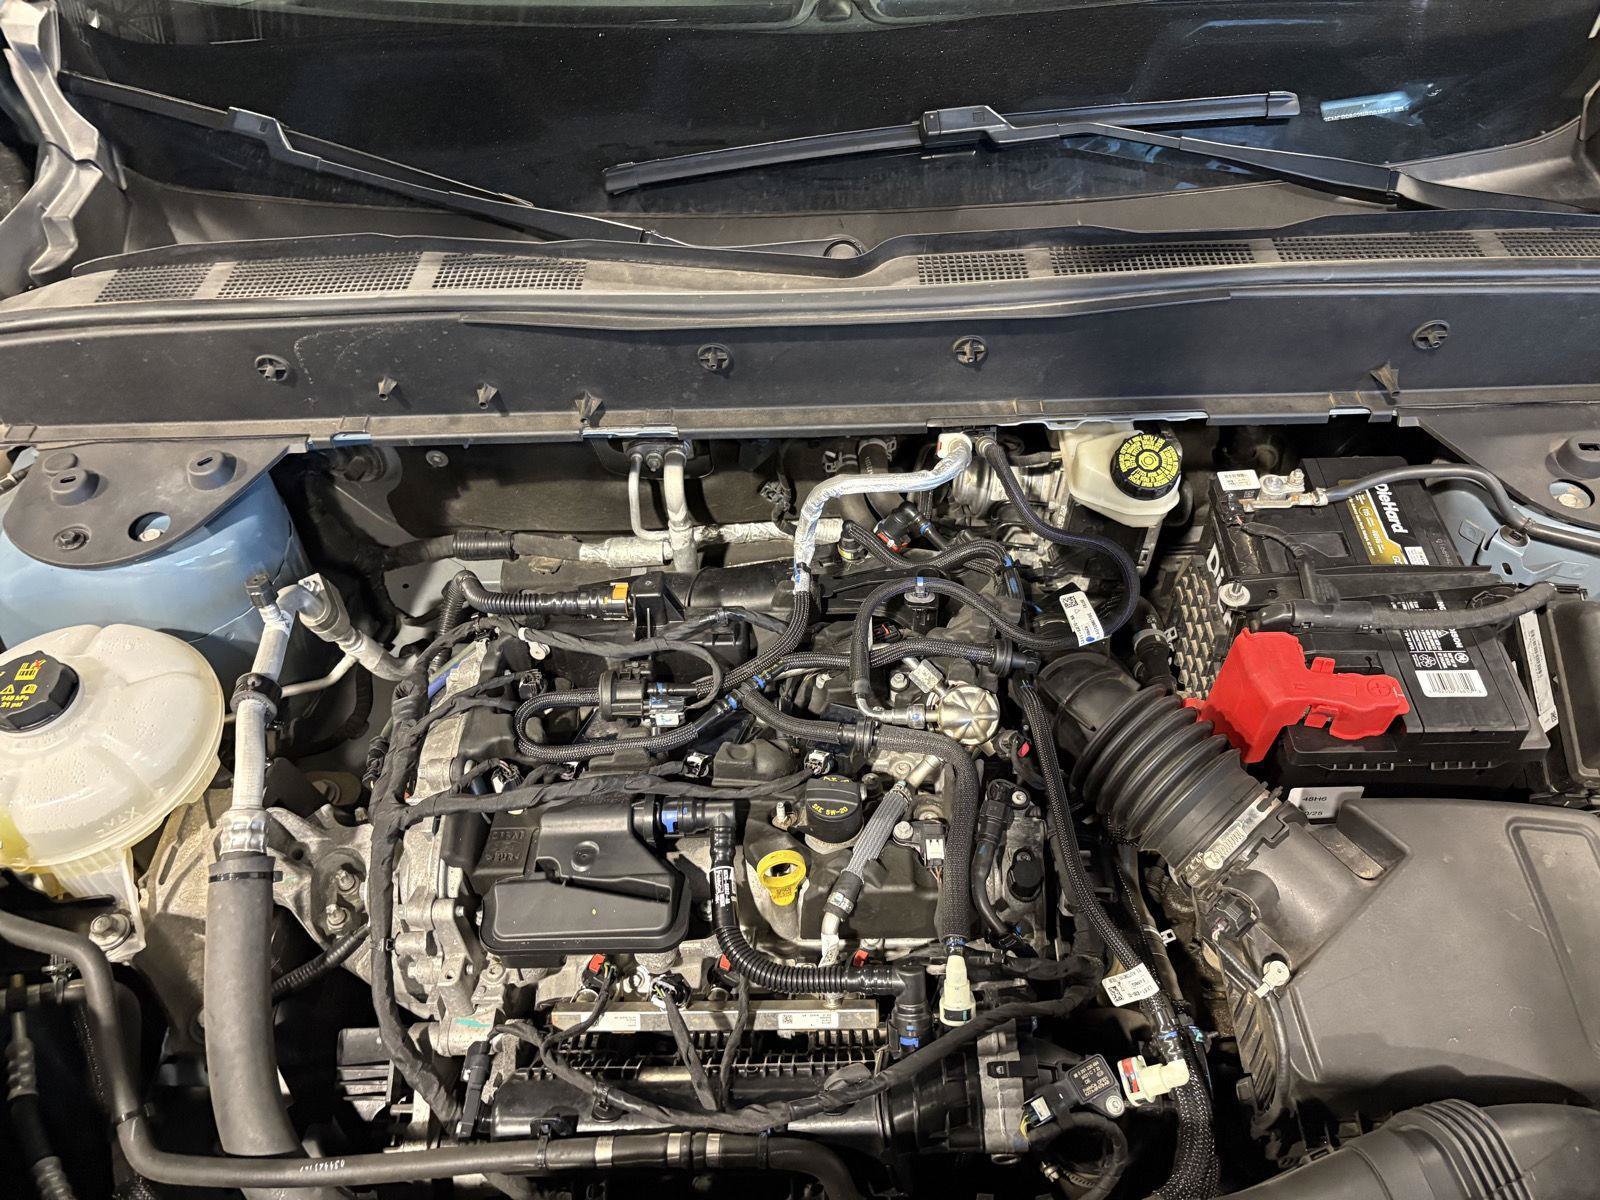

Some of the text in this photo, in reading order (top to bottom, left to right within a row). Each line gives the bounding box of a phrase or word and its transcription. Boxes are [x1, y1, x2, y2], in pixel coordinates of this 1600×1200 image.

[1374, 483, 1409, 534] DieHard
[812, 803, 848, 815] SAE 5W-20
